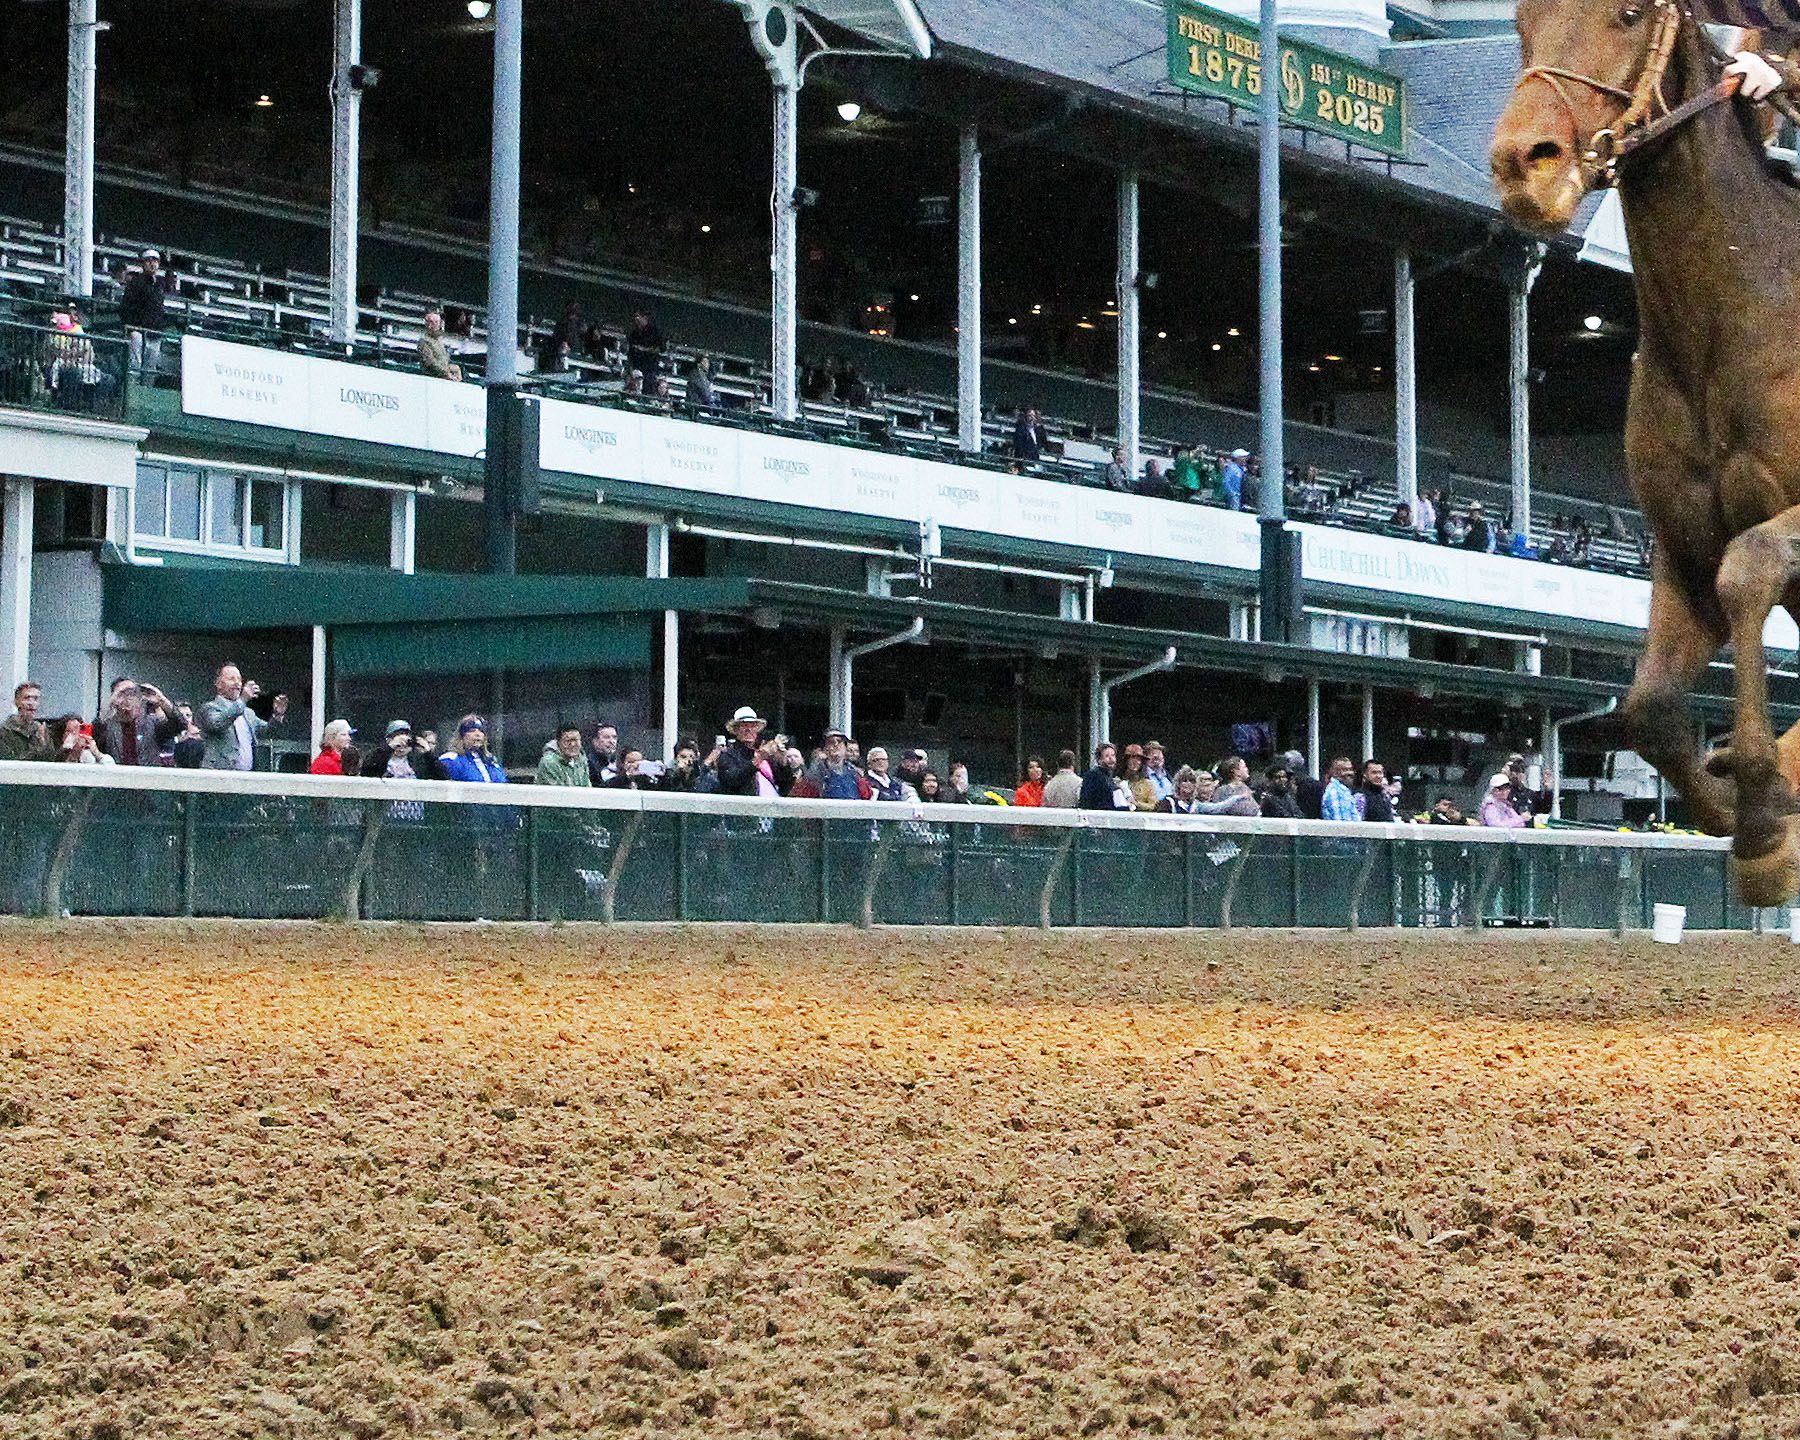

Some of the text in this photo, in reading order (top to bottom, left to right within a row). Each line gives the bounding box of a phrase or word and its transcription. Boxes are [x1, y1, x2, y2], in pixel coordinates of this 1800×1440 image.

[1178, 15, 1221, 48] FIRST
[1188, 45, 1262, 96] 1875
[1346, 74, 1396, 107] DERBY
[1316, 88, 1385, 135] 2025
[214, 363, 283, 385] WOODFORD
[221, 383, 279, 405] RESERVE
[339, 388, 400, 412] LONGINES
[564, 424, 617, 446] LONGINES
[763, 456, 810, 475] LONGINES
[1306, 535, 1392, 580] CHURCHILL
[1397, 551, 1451, 590] DOWNS
